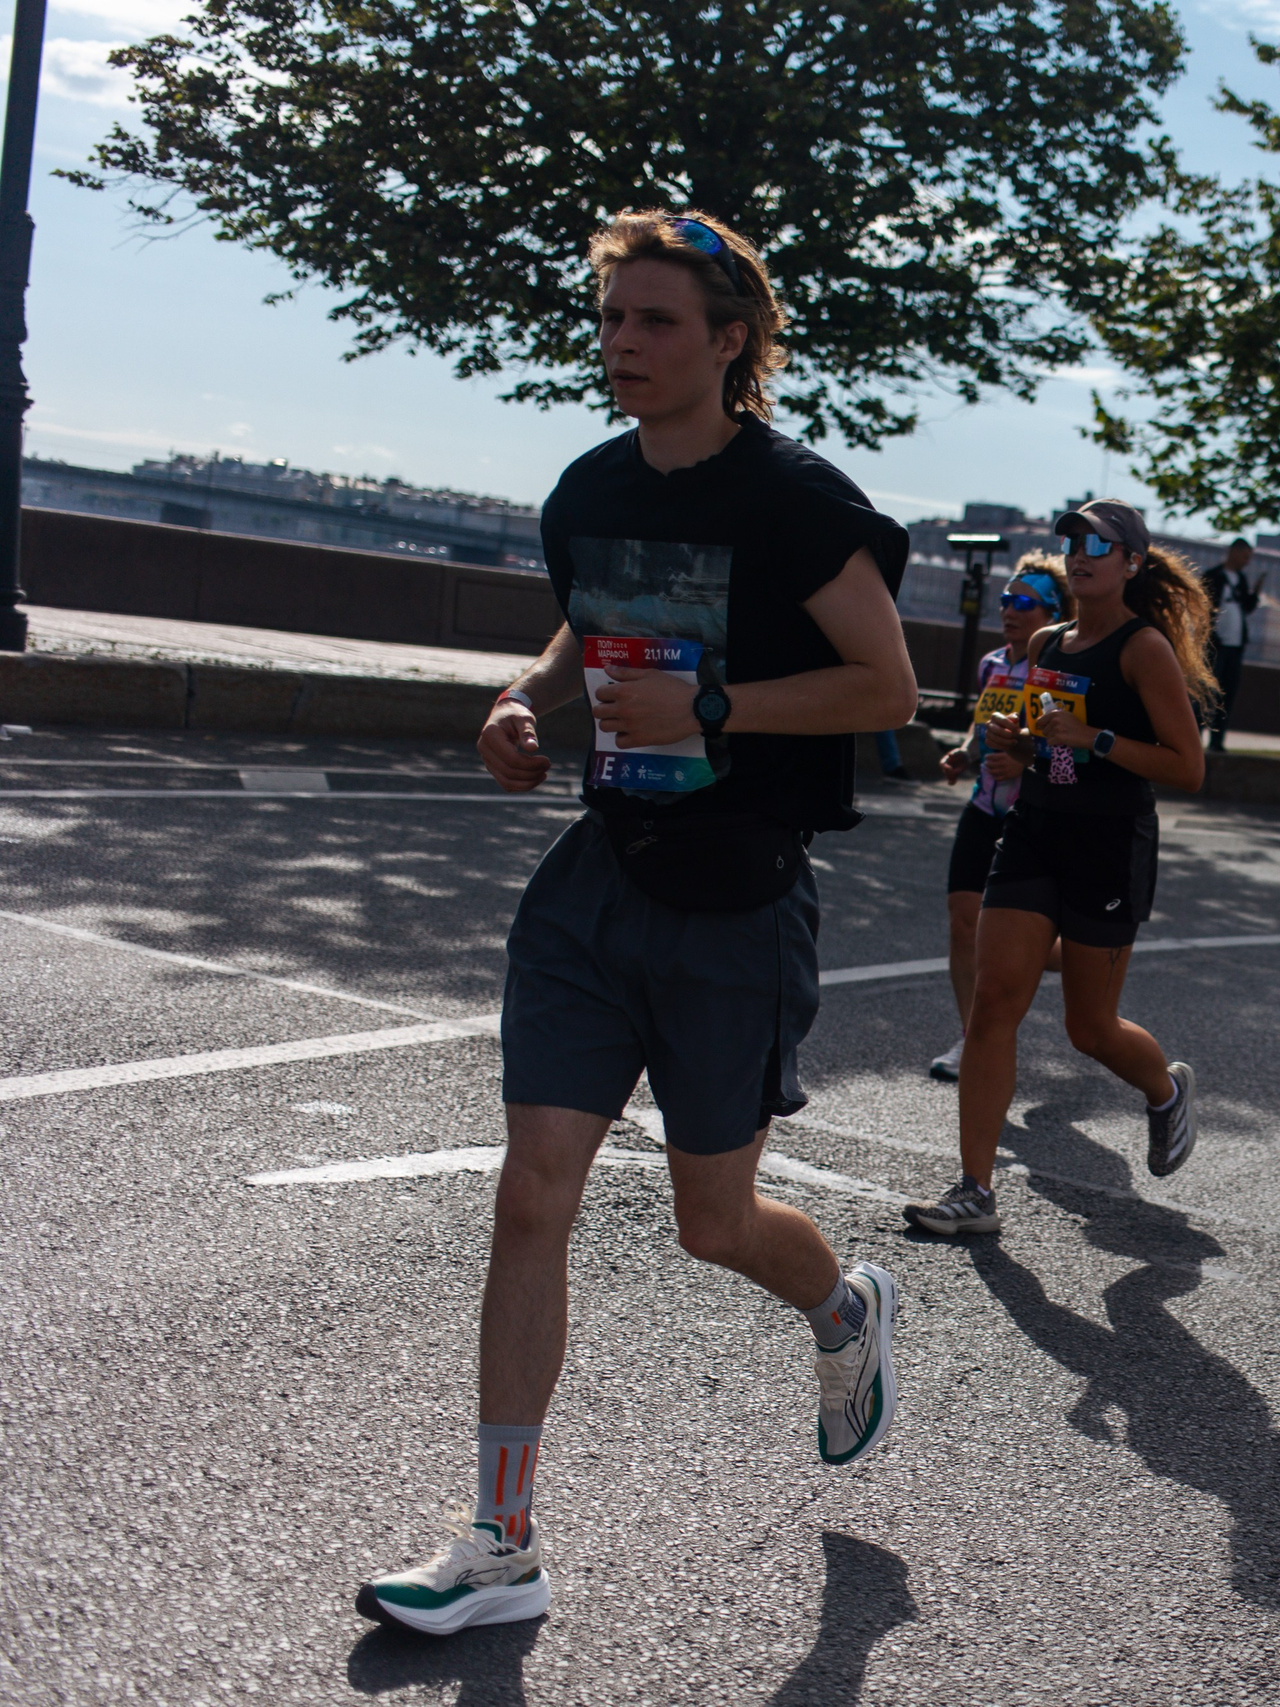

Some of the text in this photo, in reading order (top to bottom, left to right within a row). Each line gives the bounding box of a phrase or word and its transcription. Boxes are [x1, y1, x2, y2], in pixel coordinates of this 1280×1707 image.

[597, 640, 613, 649] ПОЛУ
[597, 650, 629, 659] МАРАФОН
[644, 648, 661, 661] 21,1
[980, 692, 1017, 713] 5365
[1030, 693, 1075, 719] 57
